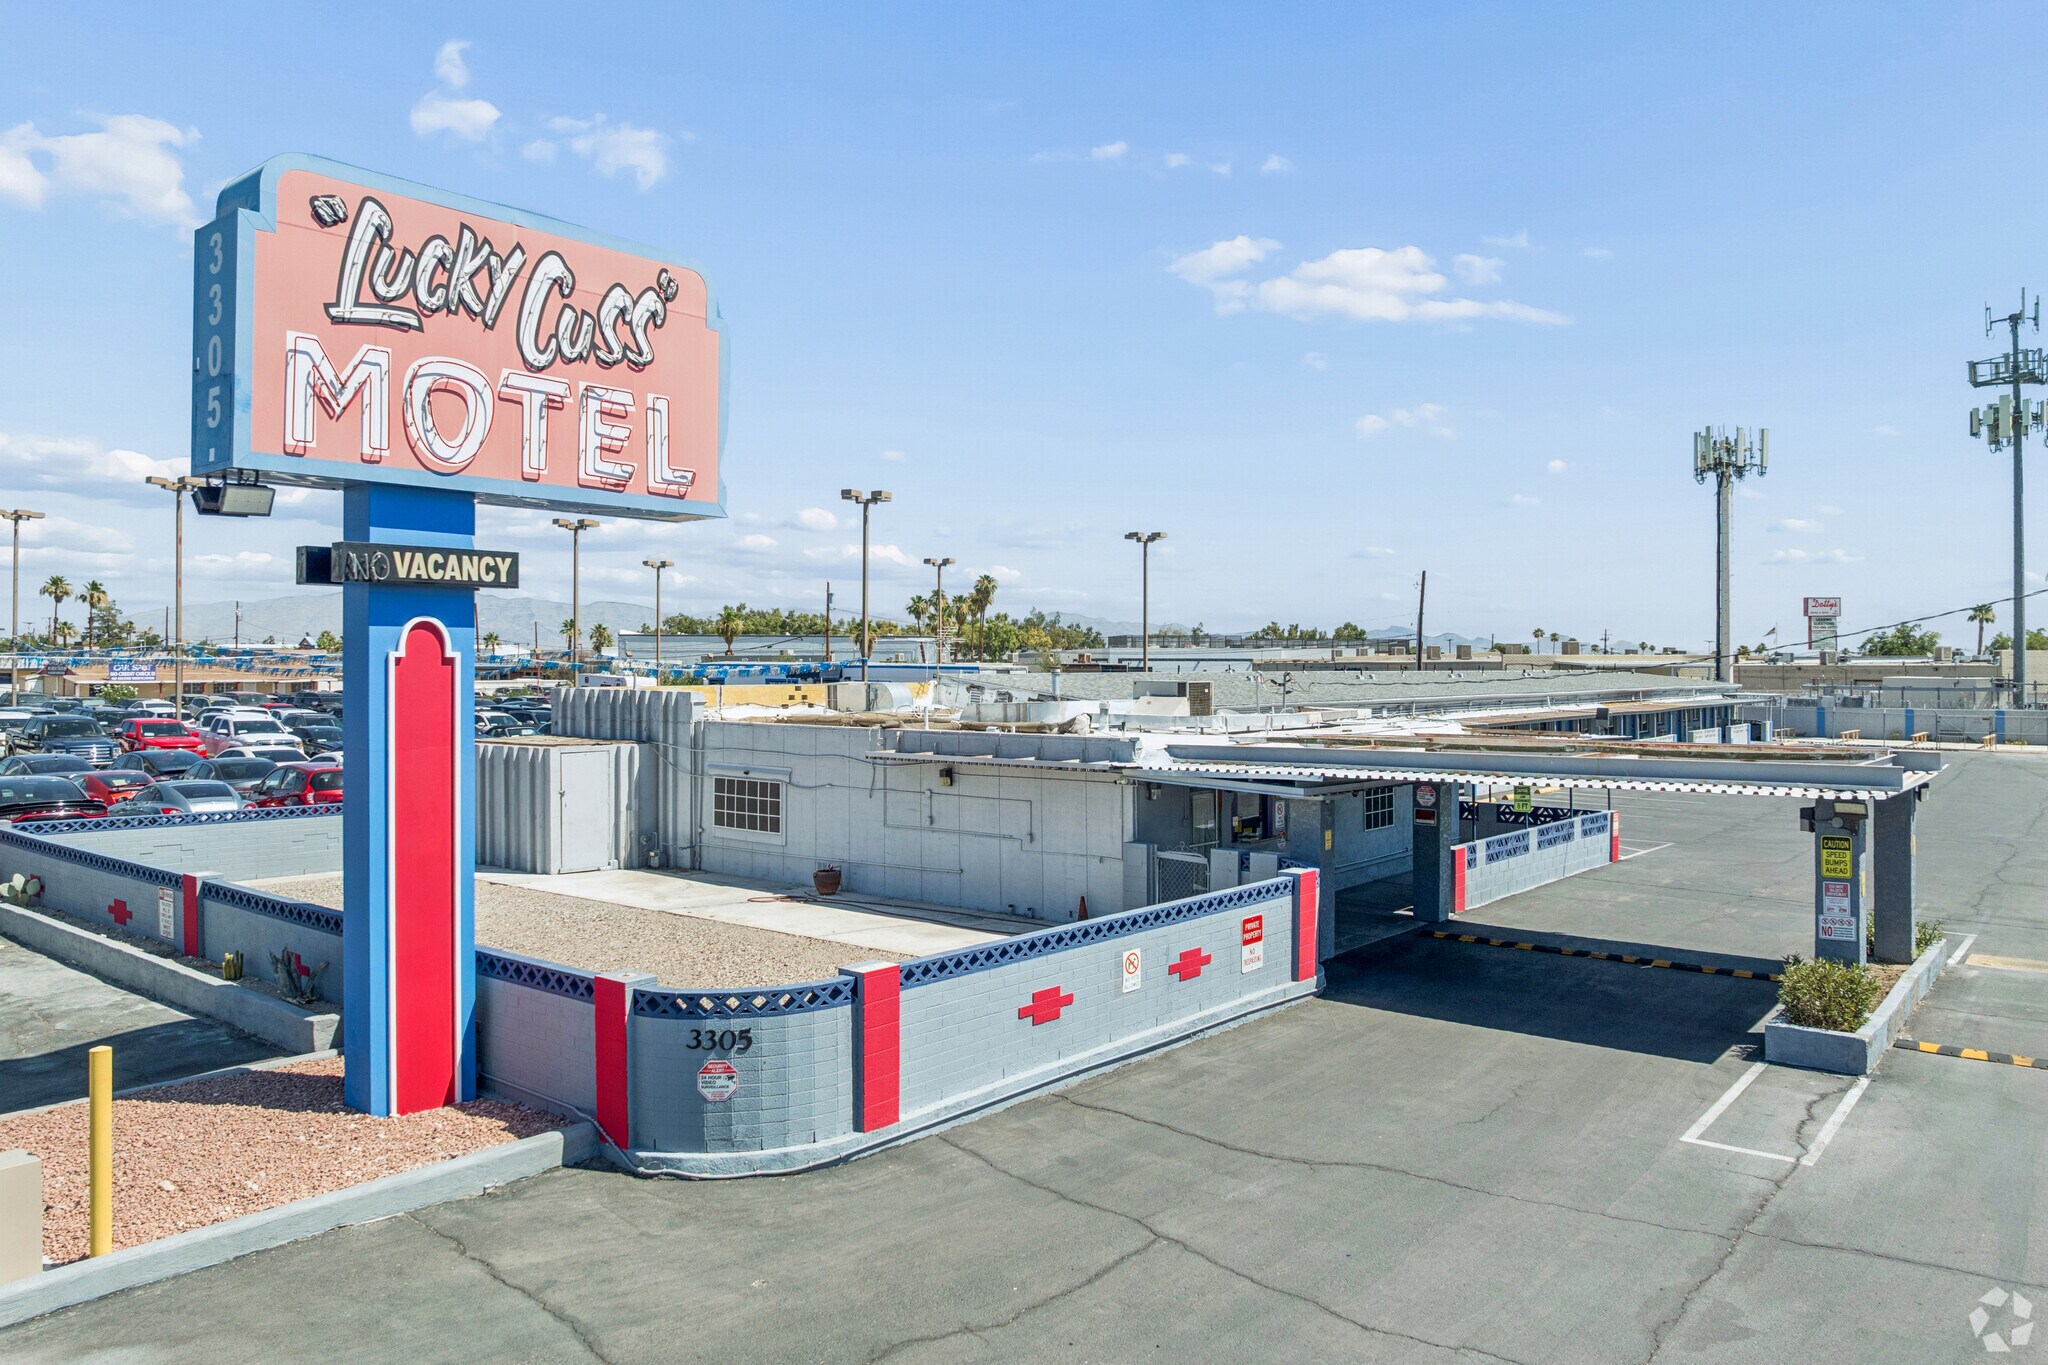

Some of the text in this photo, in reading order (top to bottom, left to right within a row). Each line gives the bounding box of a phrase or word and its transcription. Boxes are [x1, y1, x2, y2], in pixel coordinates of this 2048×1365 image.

[284, 330, 696, 498] MOTEL
[346, 550, 512, 582] NO VACANCY
[1824, 839, 1850, 849] CAUTION
[1826, 851, 1847, 859] SPEED
[1825, 859, 1848, 867] BUMPS
[1825, 866, 1848, 875] AHEAD
[1244, 920, 1260, 931] PRIVATE
[1822, 925, 1833, 936] NO
[1243, 929, 1262, 941] PROPERTY
[686, 1027, 753, 1051] 3305
